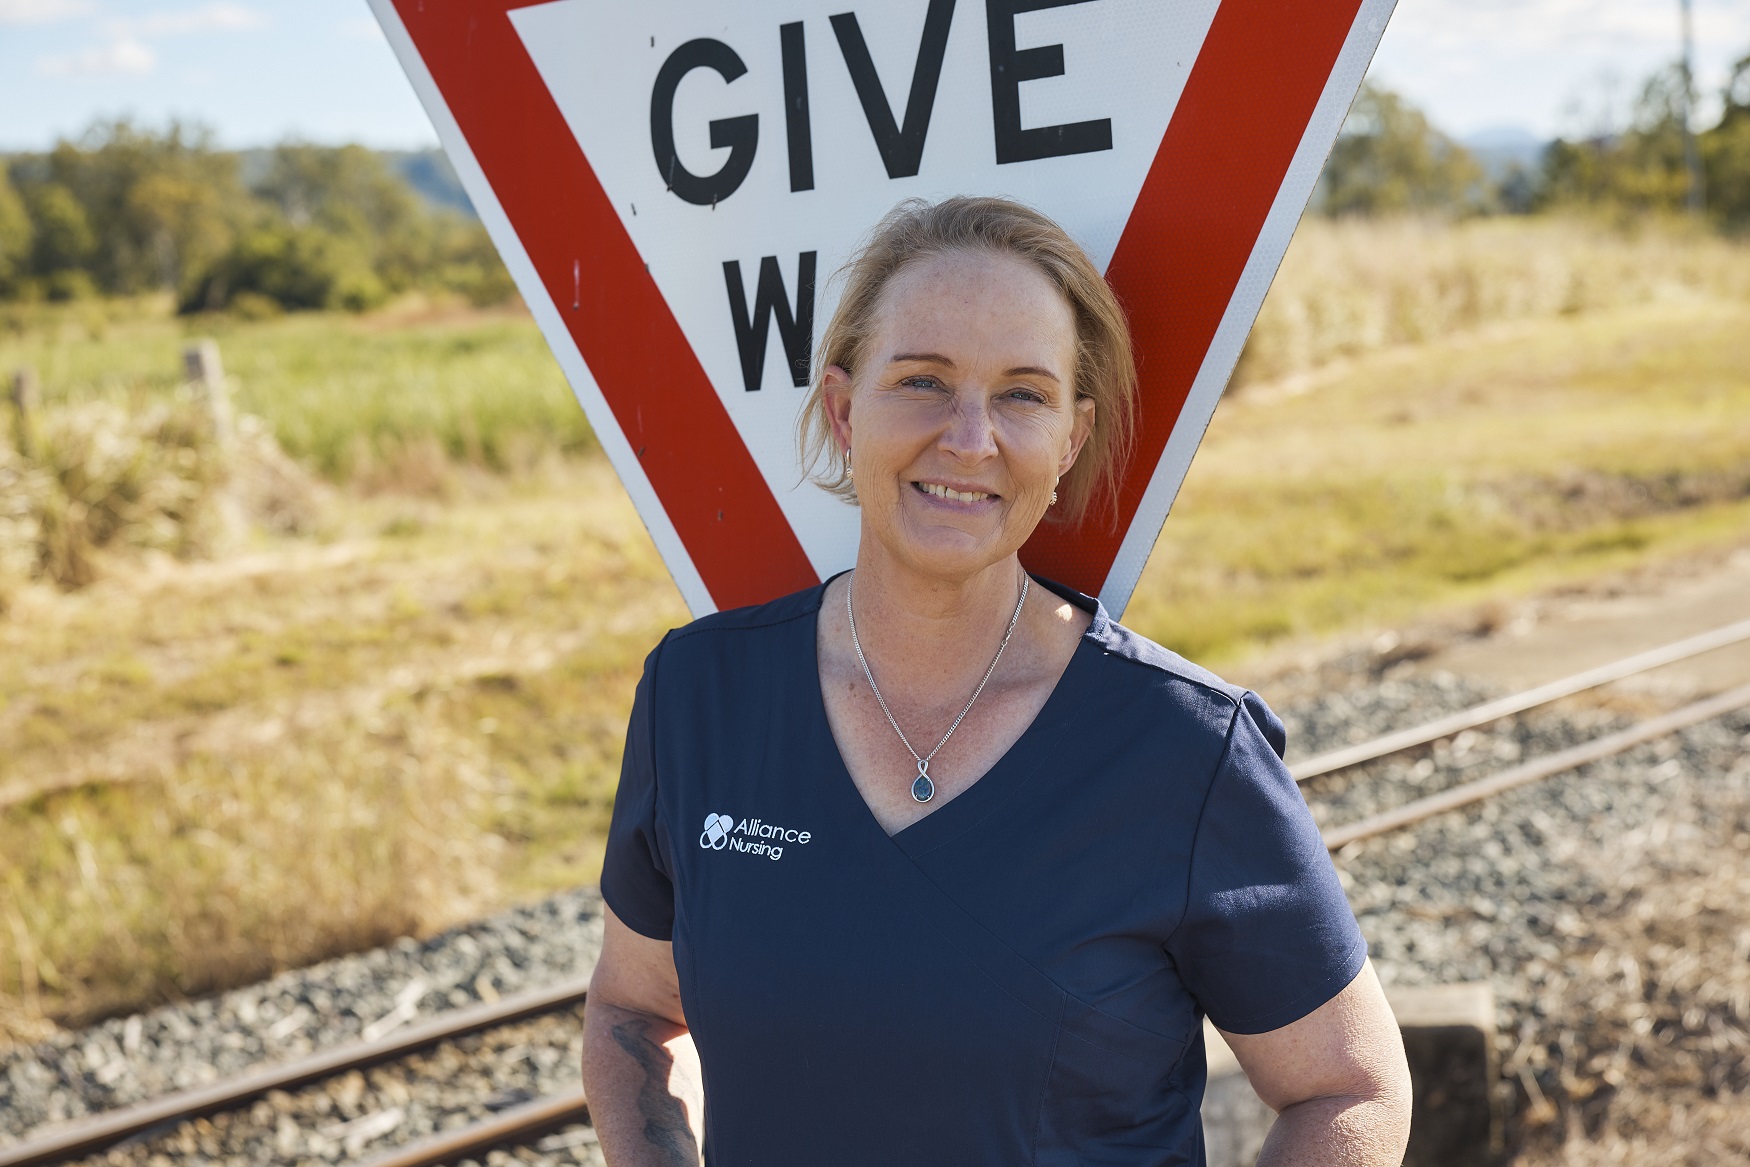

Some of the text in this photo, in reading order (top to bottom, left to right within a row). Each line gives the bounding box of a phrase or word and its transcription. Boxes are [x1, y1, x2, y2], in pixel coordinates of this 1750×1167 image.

[650, 0, 1114, 206] GIVE
[734, 818, 811, 844] Alliance
[729, 837, 783, 861] Nursing
